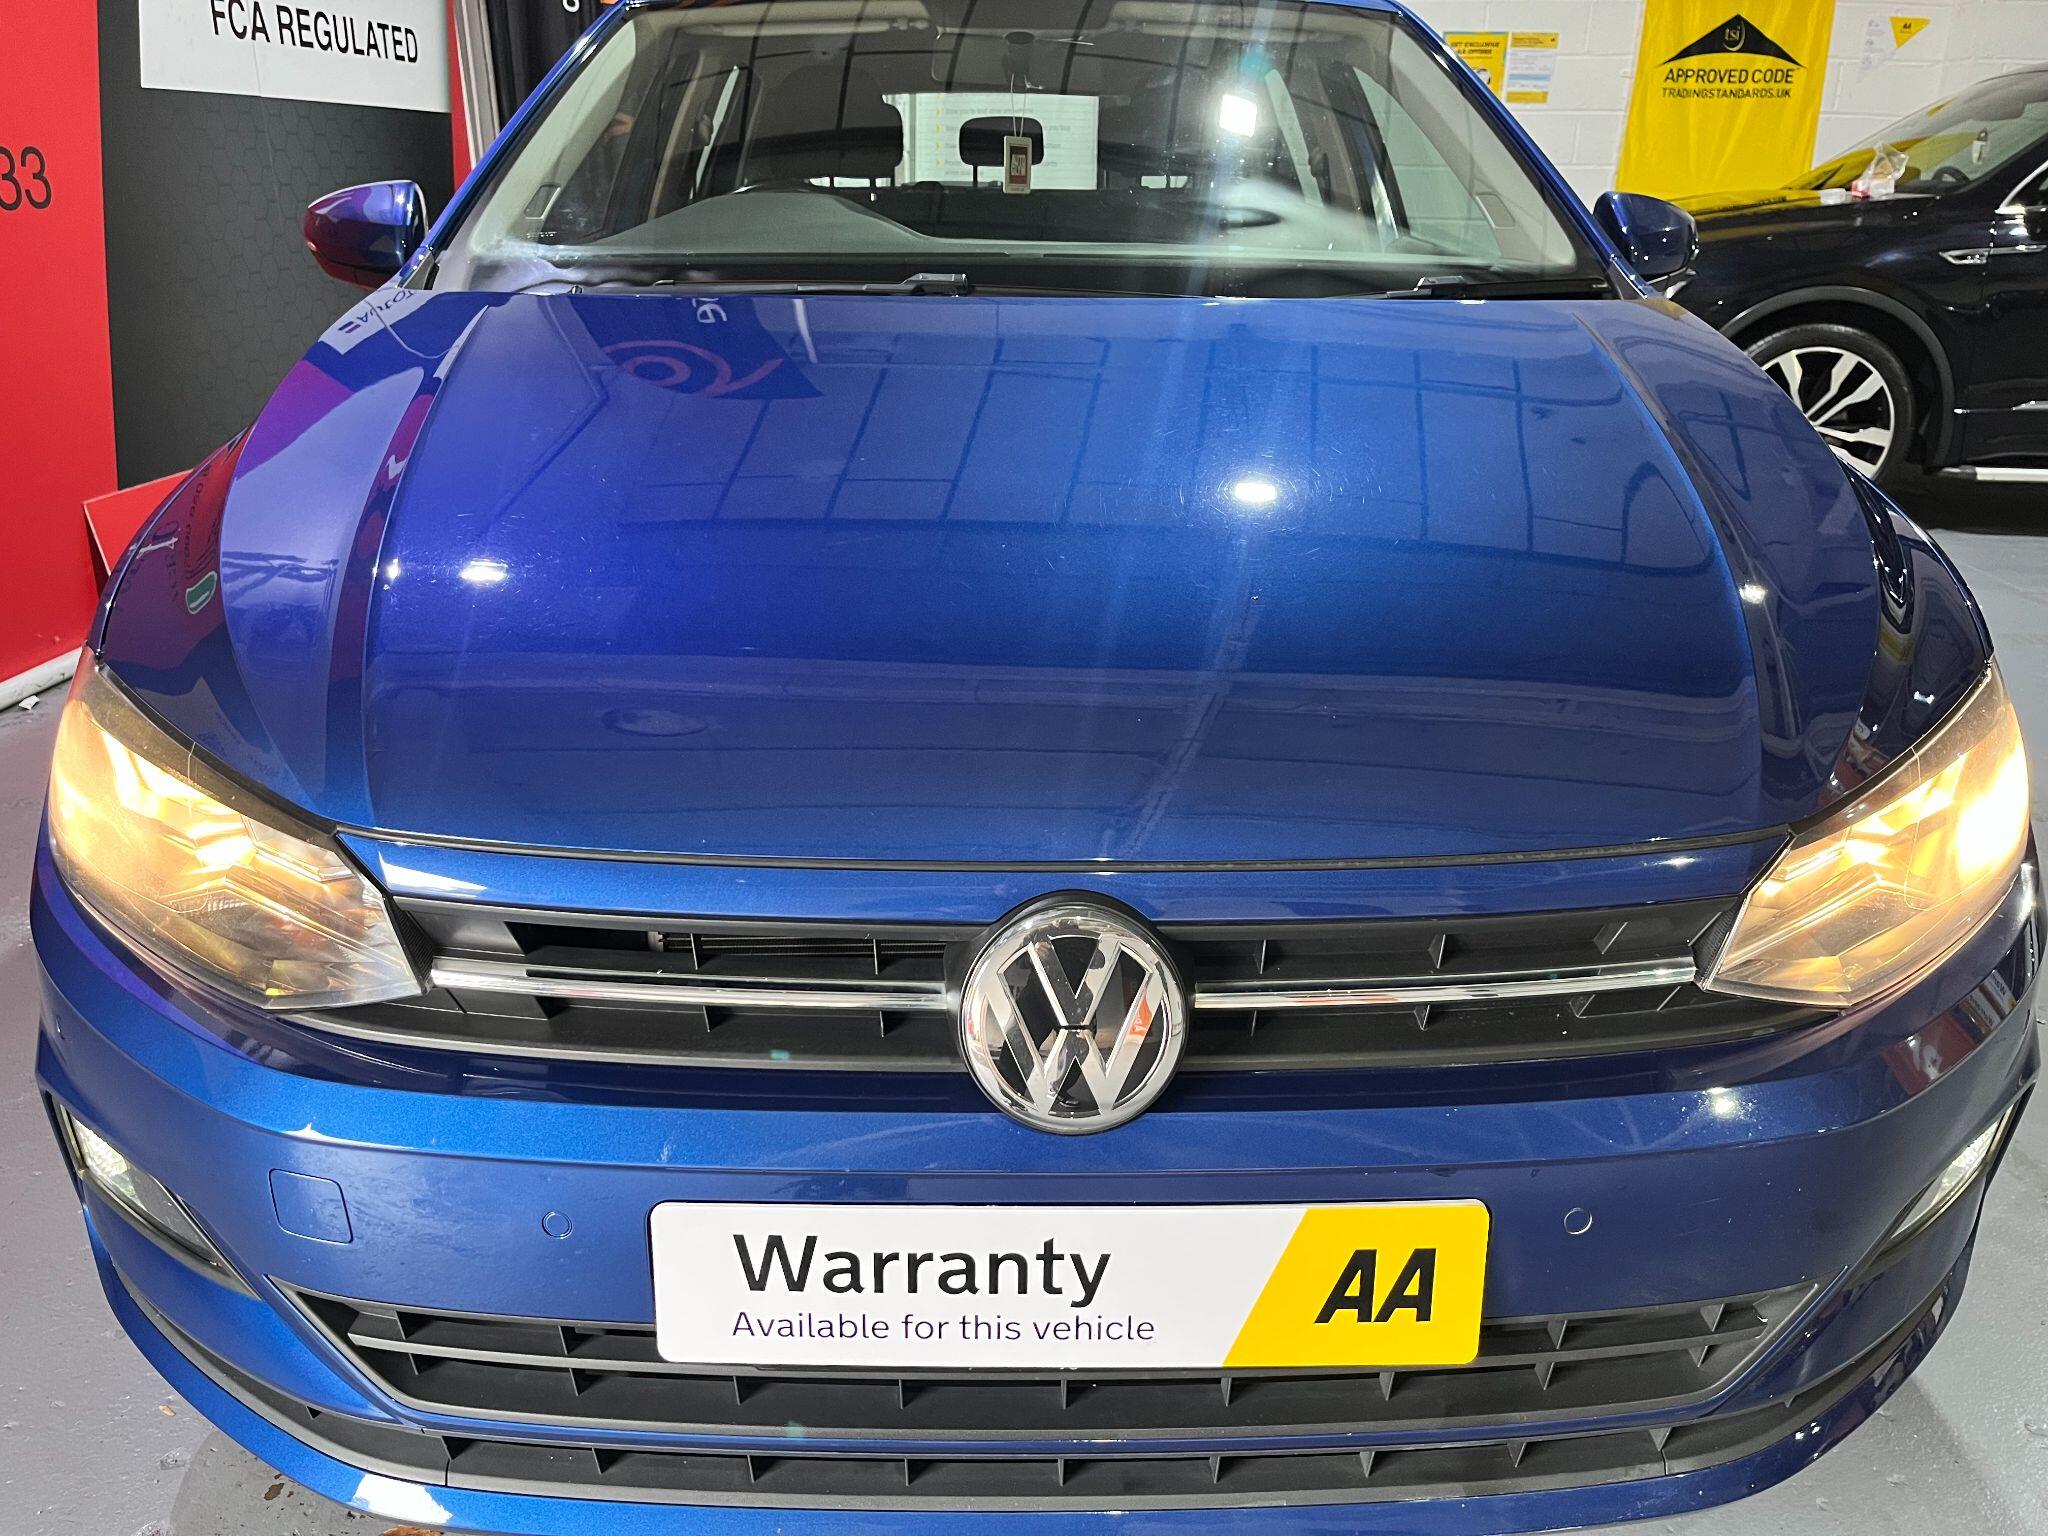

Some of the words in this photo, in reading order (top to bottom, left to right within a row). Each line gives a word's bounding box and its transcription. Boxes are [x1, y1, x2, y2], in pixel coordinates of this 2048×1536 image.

[210, 0, 271, 43] FCA
[276, 4, 418, 63] REGULATED
[1662, 87, 1792, 99] TRADINGSTANDARDS.UK
[1664, 68, 1749, 83] APPROVED
[1752, 68, 1794, 83] CODE
[732, 1234, 1111, 1308] Warranty
[1313, 1248, 1437, 1324] AA
[732, 1311, 890, 1340] Available
[901, 1313, 950, 1340] for
[958, 1314, 1021, 1341] this
[1032, 1315, 1155, 1341] vehicle
